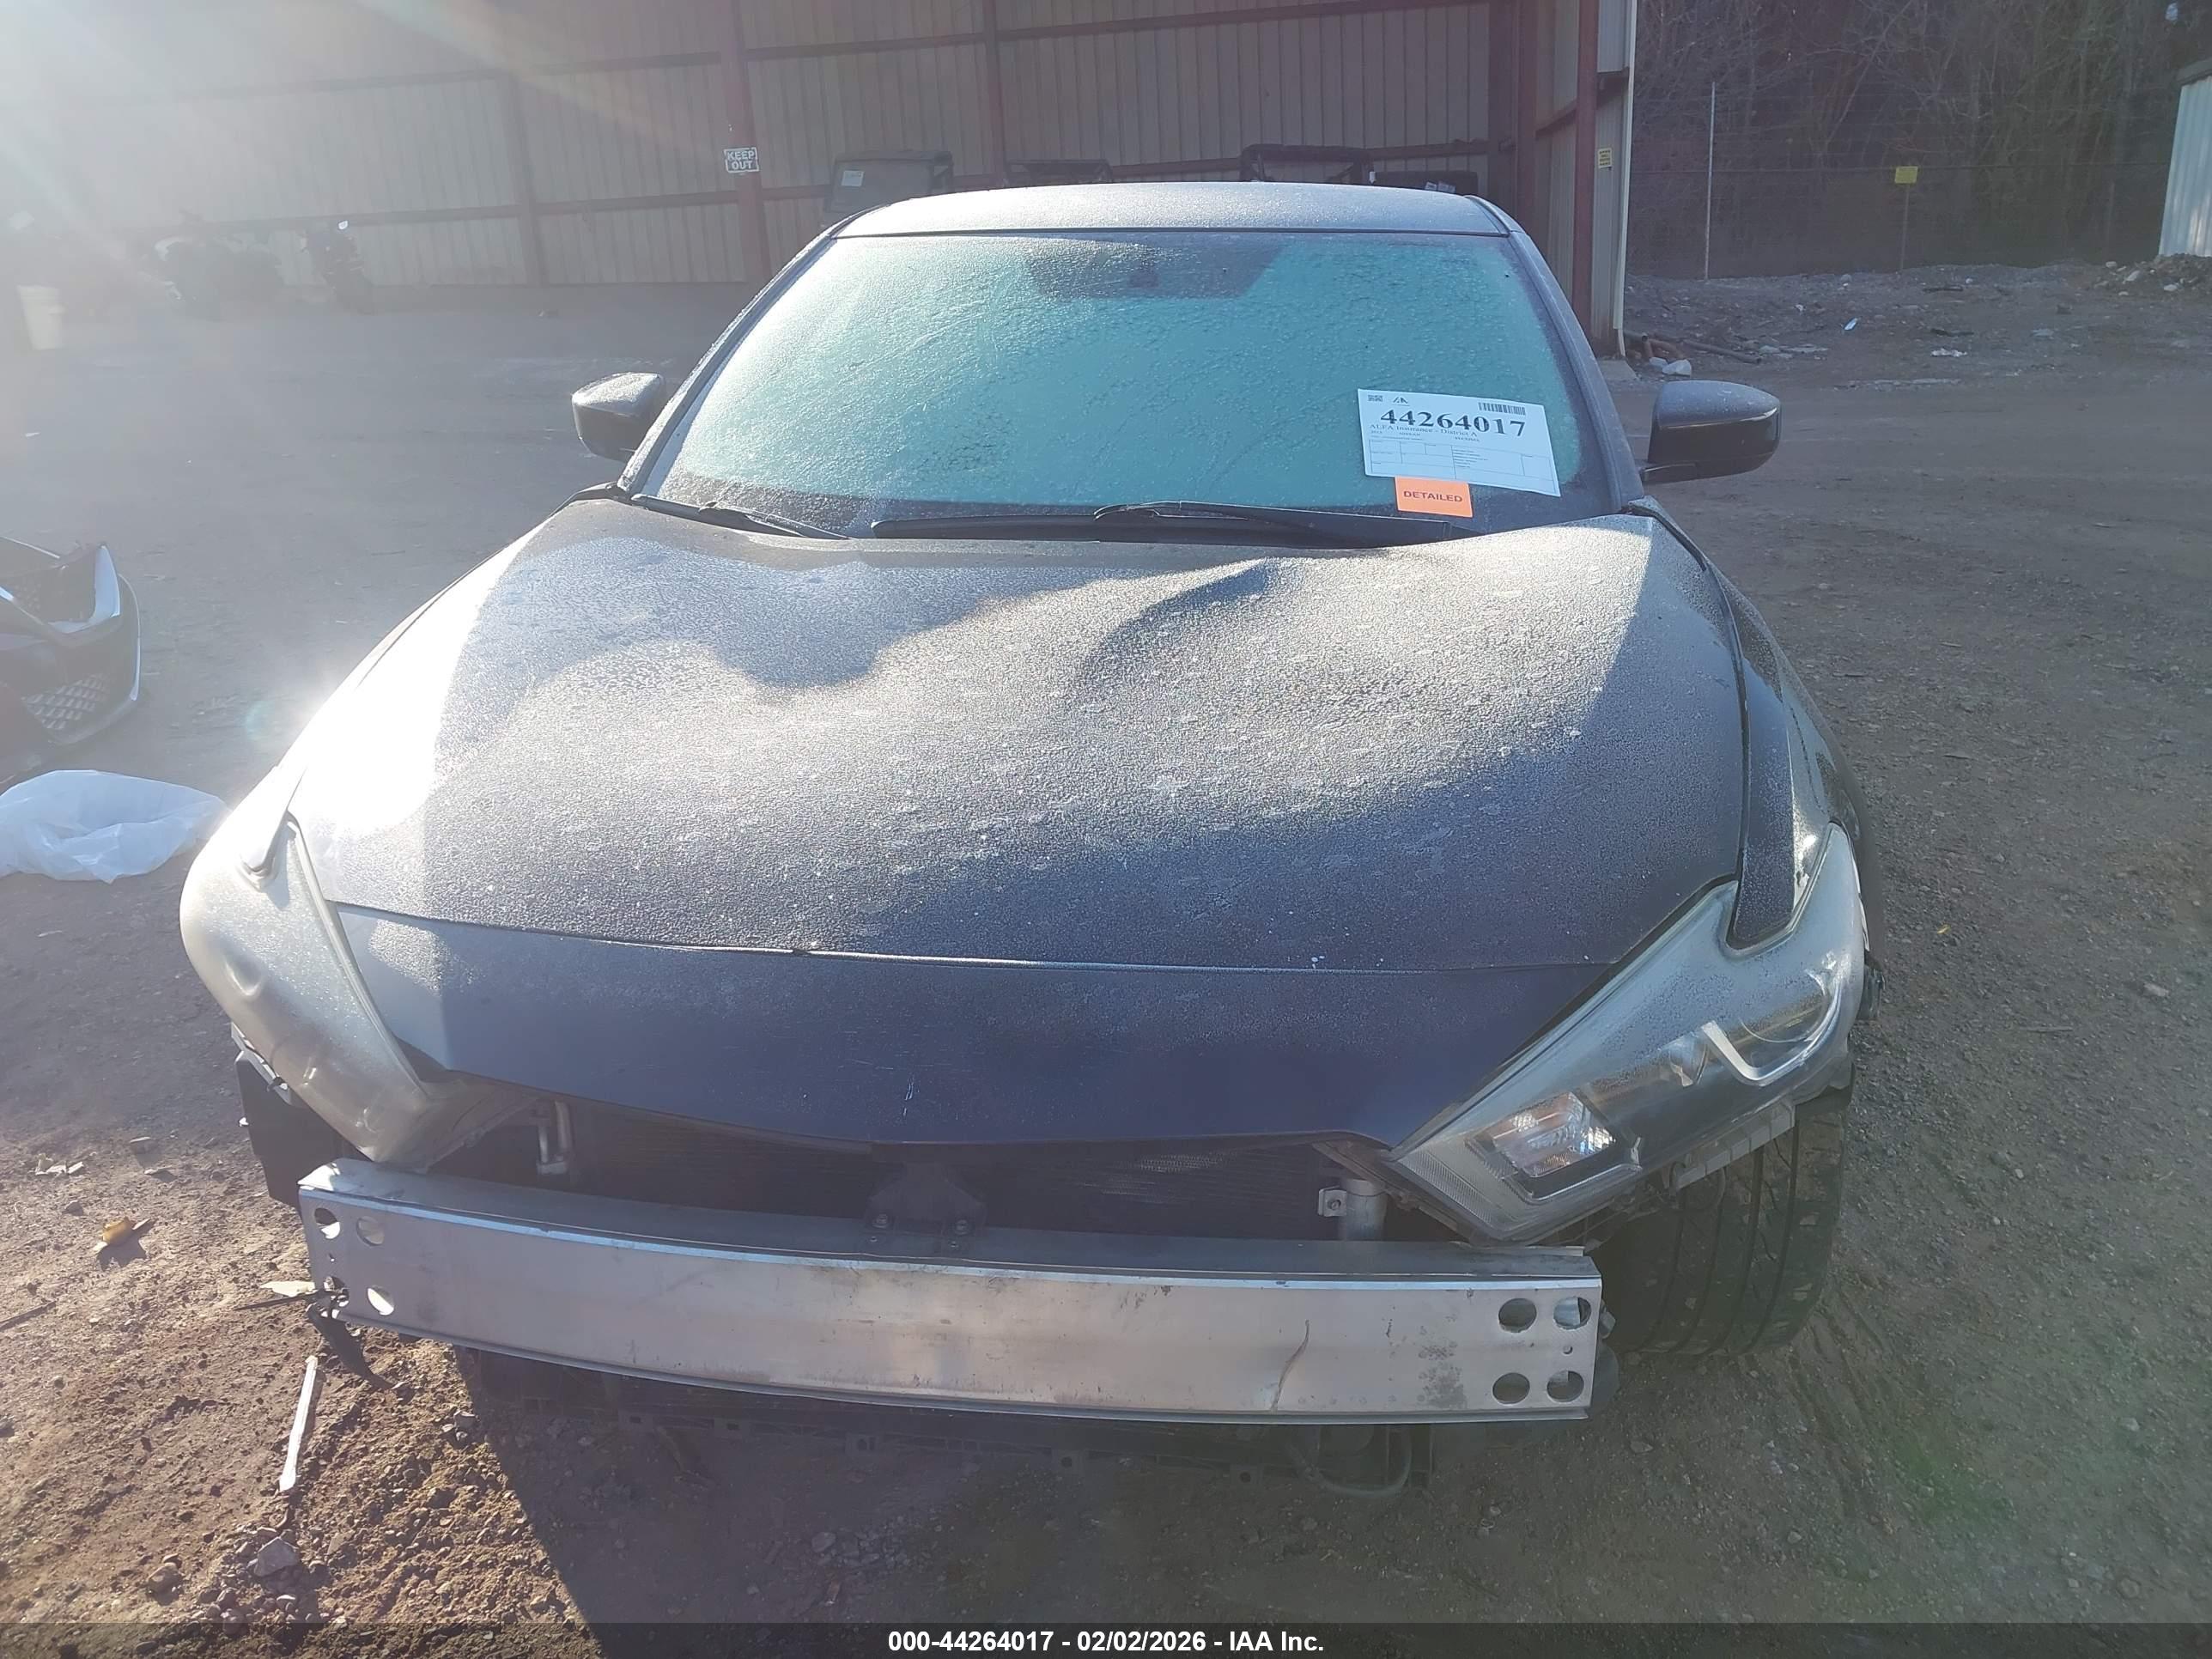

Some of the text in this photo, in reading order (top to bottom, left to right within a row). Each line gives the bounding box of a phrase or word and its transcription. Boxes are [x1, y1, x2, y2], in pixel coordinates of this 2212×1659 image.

[727, 150, 755, 161] KEEP
[732, 161, 753, 170] OUT
[1380, 409, 1526, 436] 44264017
[1403, 490, 1463, 502] DETAILED
